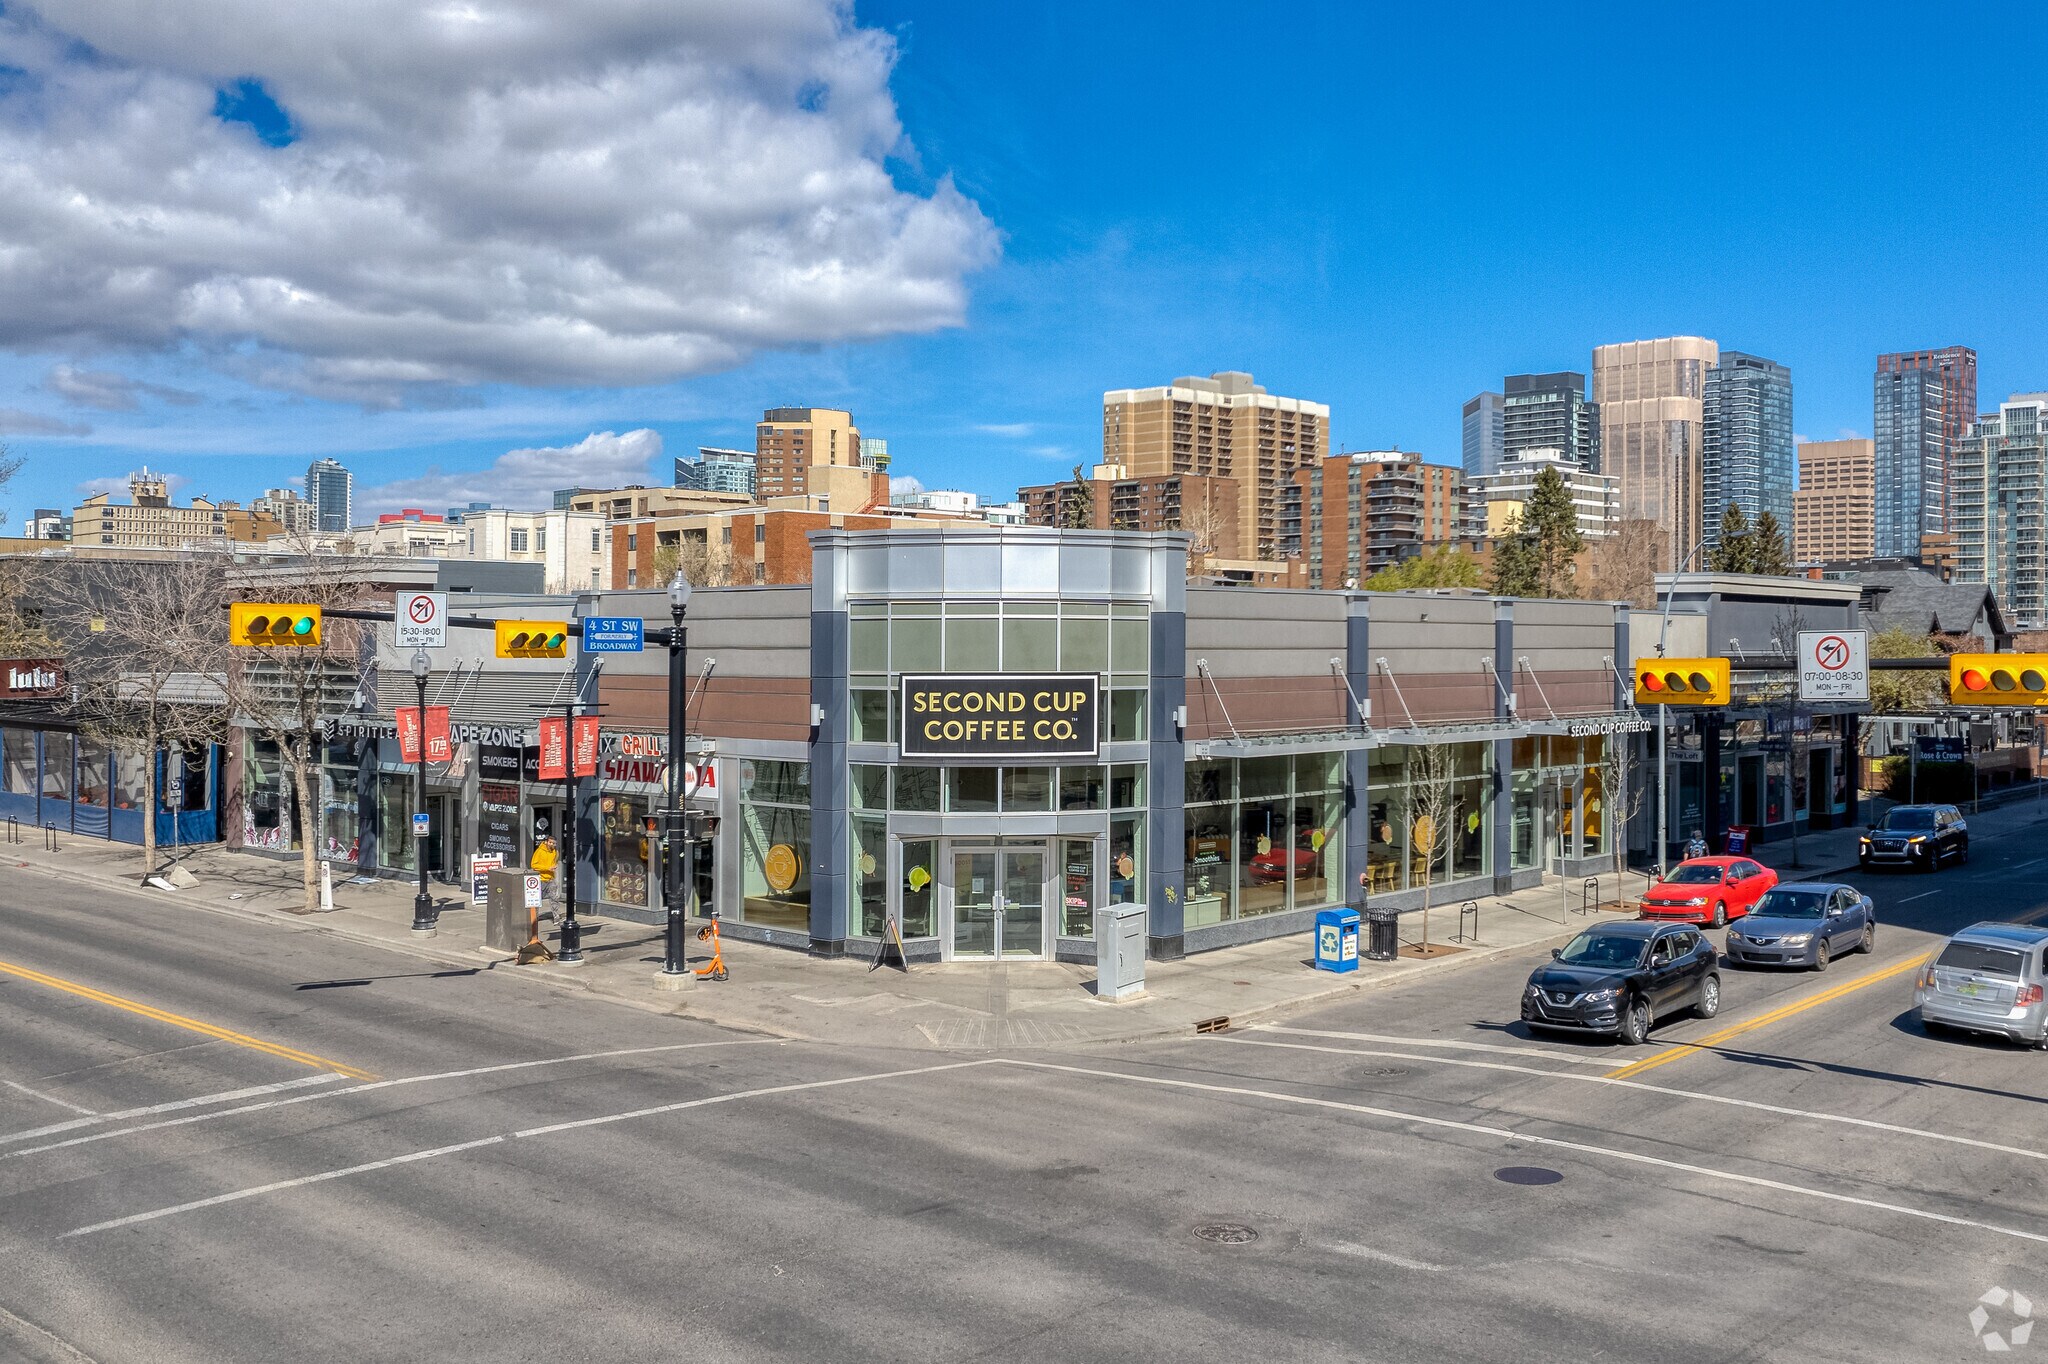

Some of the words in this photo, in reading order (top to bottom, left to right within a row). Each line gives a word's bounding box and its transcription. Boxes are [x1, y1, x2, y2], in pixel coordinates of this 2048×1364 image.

[589, 620, 597, 631] 4
[602, 620, 617, 631] ST
[621, 620, 638, 631] SW
[400, 627, 441, 636] 15:30-18:00
[589, 642, 638, 650] BROADWAY
[1804, 671, 1863, 681] 07:00-08:30
[1816, 683, 1832, 691] MON
[1841, 683, 1853, 691] FRI
[913, 691, 1026, 713] SECOND
[1033, 691, 1087, 713] CUP
[923, 719, 1026, 741] COFFEE
[1033, 719, 1078, 741] CO.
[1571, 723, 1600, 738] SECOND
[1600, 722, 1614, 735] CUP
[1615, 721, 1640, 734] COFFEE
[1640, 720, 1652, 732] CO.
[481, 727, 522, 748] ZONE
[621, 735, 661, 756] GRILL
[1684, 751, 1699, 760] Loft
[1935, 751, 1941, 759] &
[1942, 751, 1962, 759] Crown
[482, 755, 518, 768] SMOKERS
[503, 805, 518, 813] ZONE
[491, 822, 509, 831] CIGARS
[489, 834, 510, 843] SMOKING
[484, 841, 516, 852] ACCESSORIES
[1194, 855, 1220, 864] Smoothies
